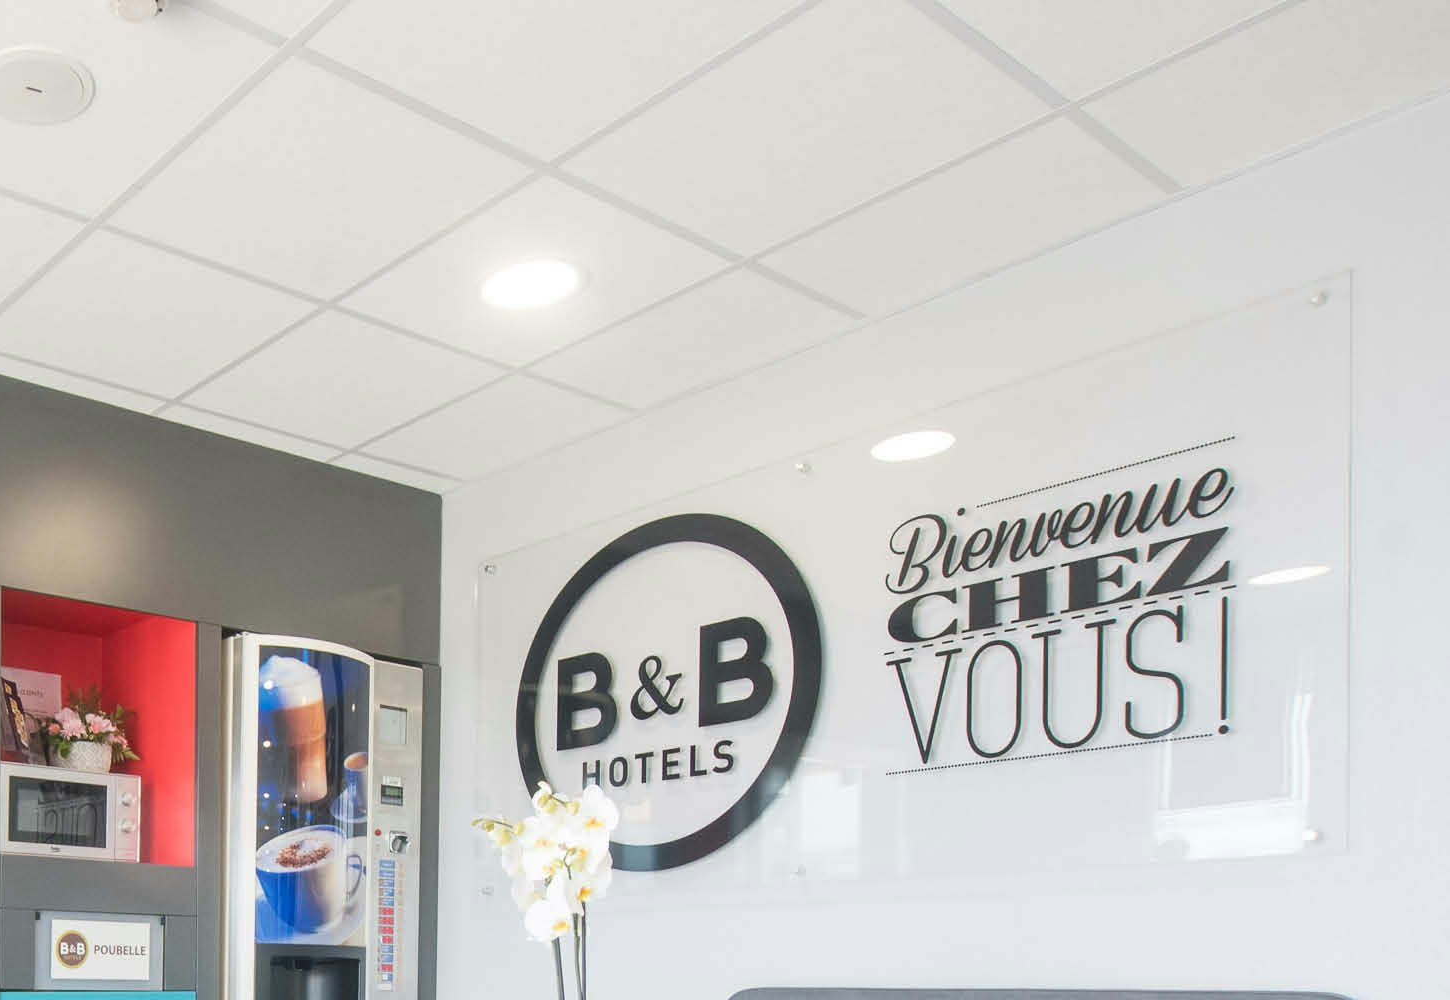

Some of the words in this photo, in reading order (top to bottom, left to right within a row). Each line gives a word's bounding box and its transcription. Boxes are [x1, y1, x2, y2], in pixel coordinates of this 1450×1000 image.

[885, 467, 1235, 595] Bienvenue
[887, 526, 1231, 643] CHEZ
[556, 616, 774, 752] B&B
[885, 596, 1231, 764] VOUS!
[582, 740, 736, 790] HOTELS
[60, 942, 85, 955] B&B
[94, 944, 147, 956] POUBELLE
